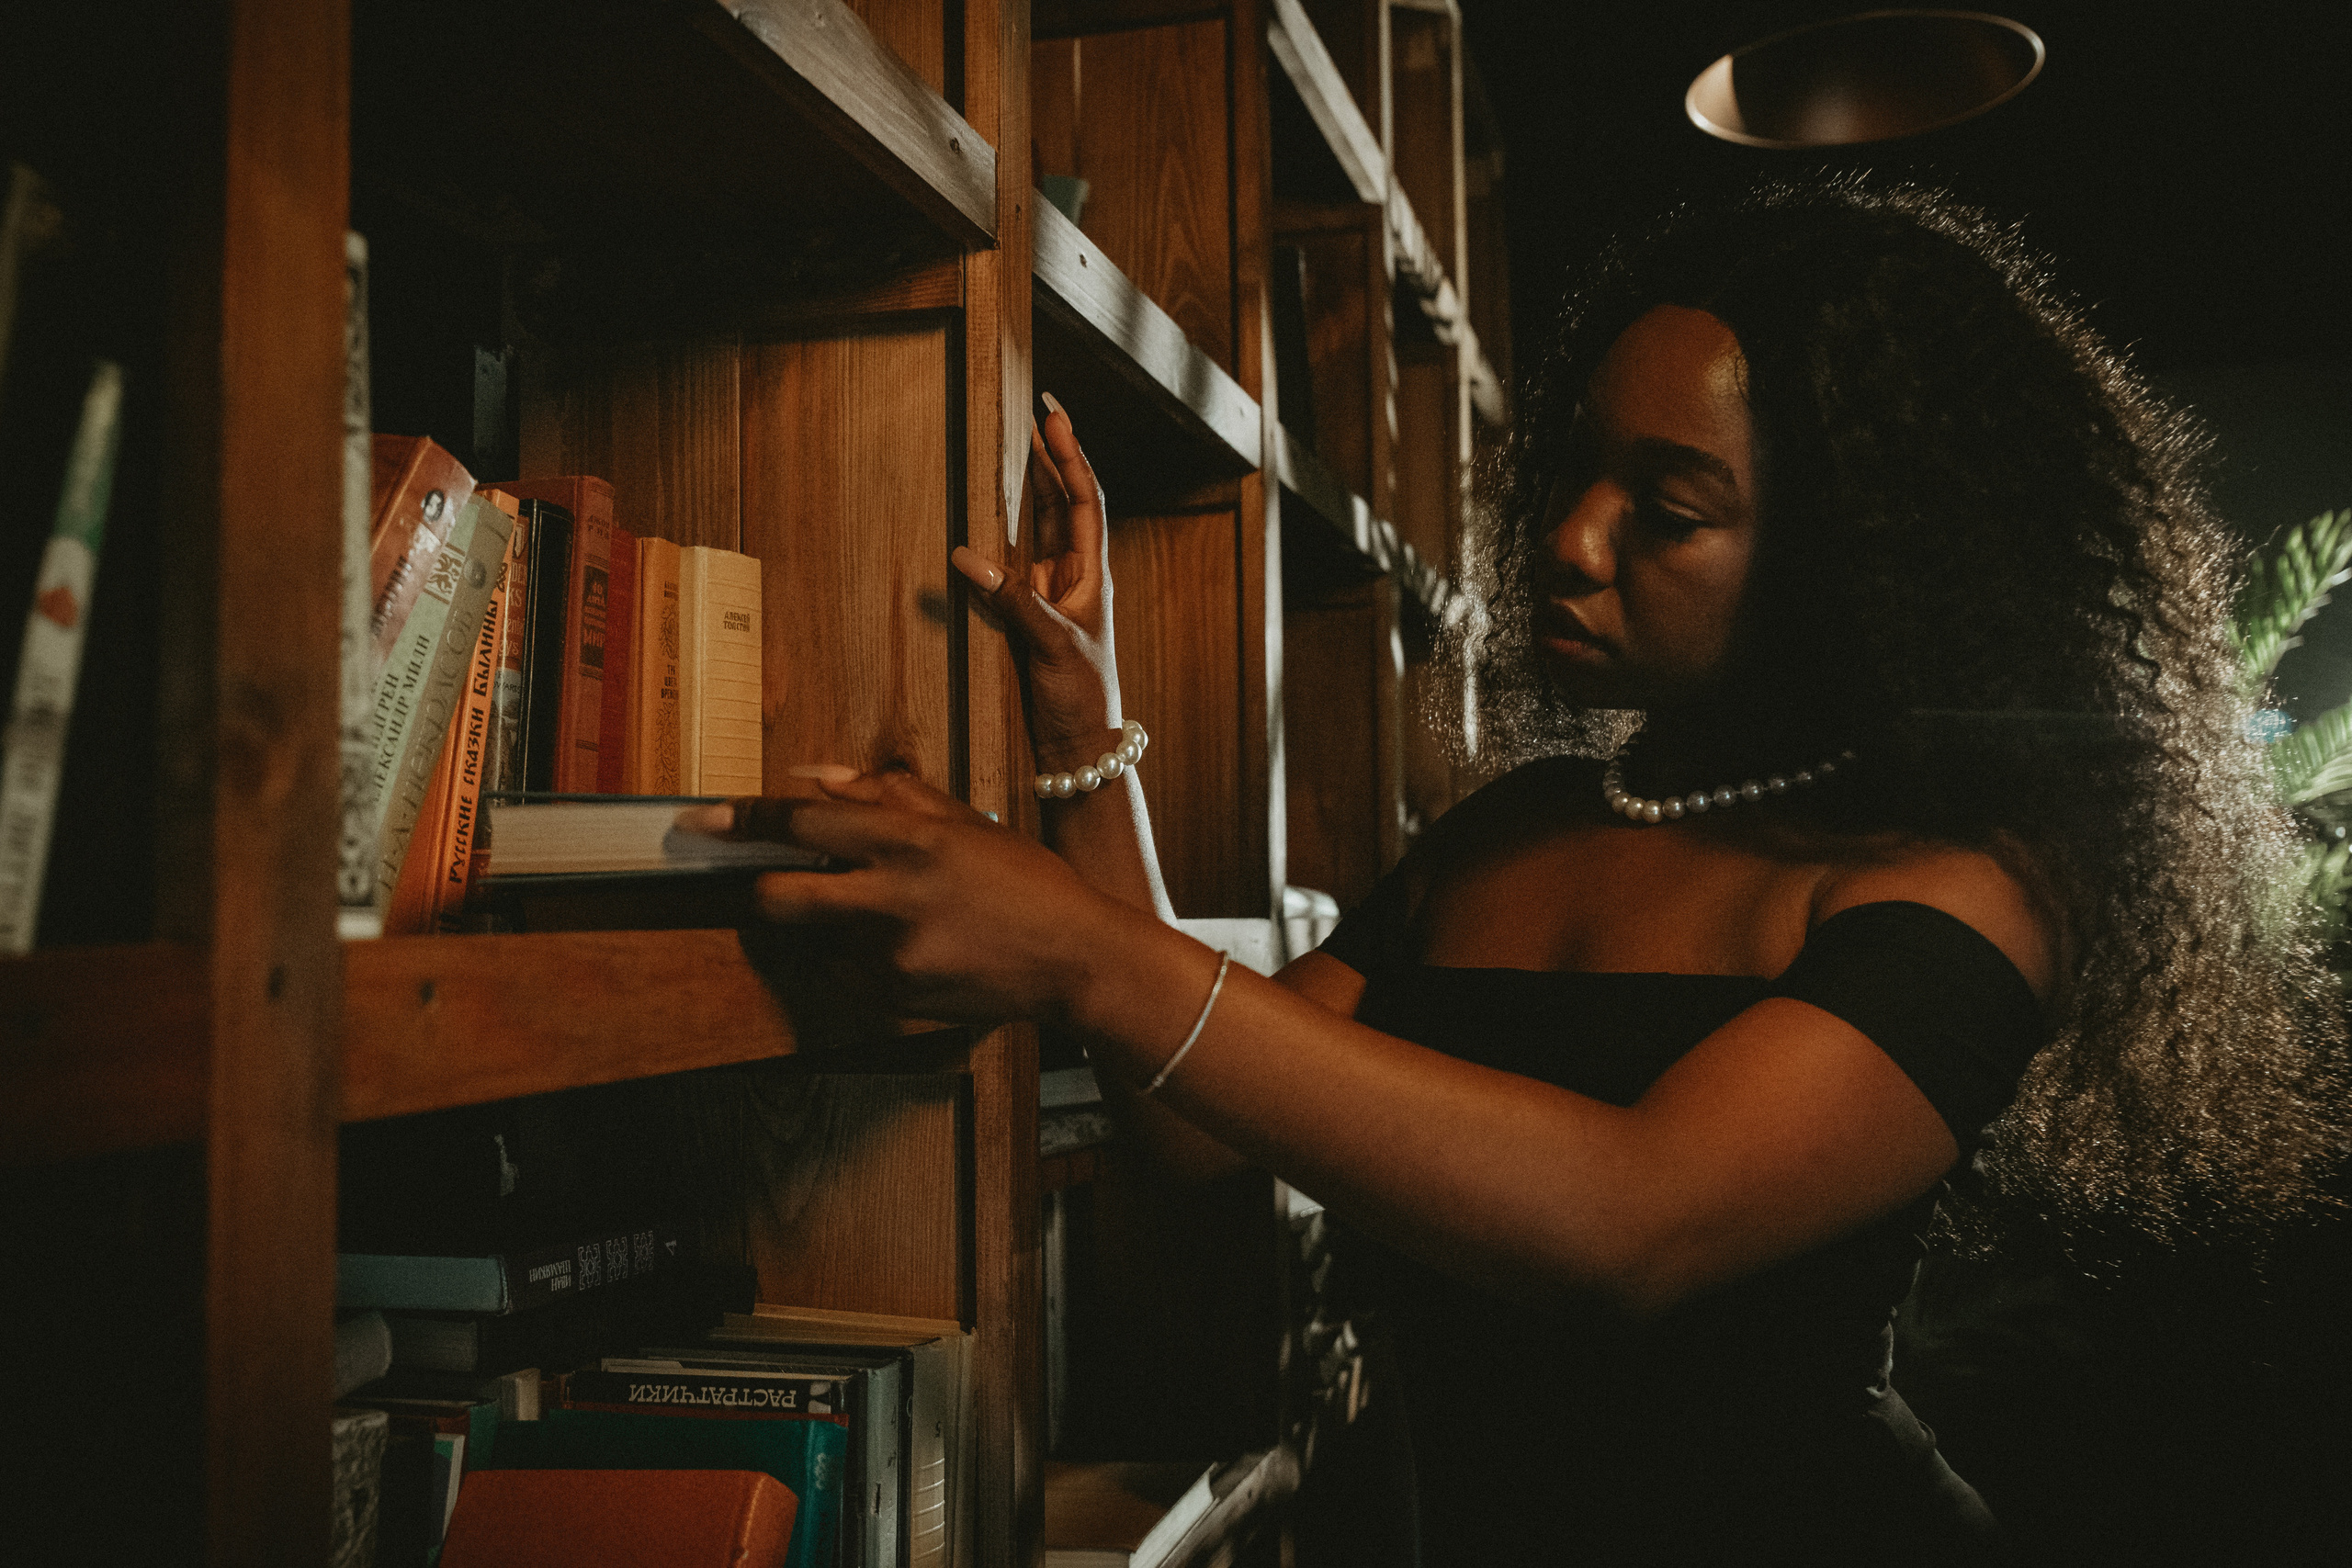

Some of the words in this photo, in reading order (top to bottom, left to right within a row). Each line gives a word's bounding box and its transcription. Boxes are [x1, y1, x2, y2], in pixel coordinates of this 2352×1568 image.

[724, 611, 751, 624] АЛЕКСЕЙ
[402, 634, 430, 694] МИЛН
[449, 795, 473, 884] РУССКИЕ
[463, 706, 485, 785] СКАЗКИ
[528, 1259, 571, 1282] ШАМЯКИН
[551, 1274, 571, 1292] ИВАН
[628, 1384, 797, 1408] РАСТРАТЧИКИ
